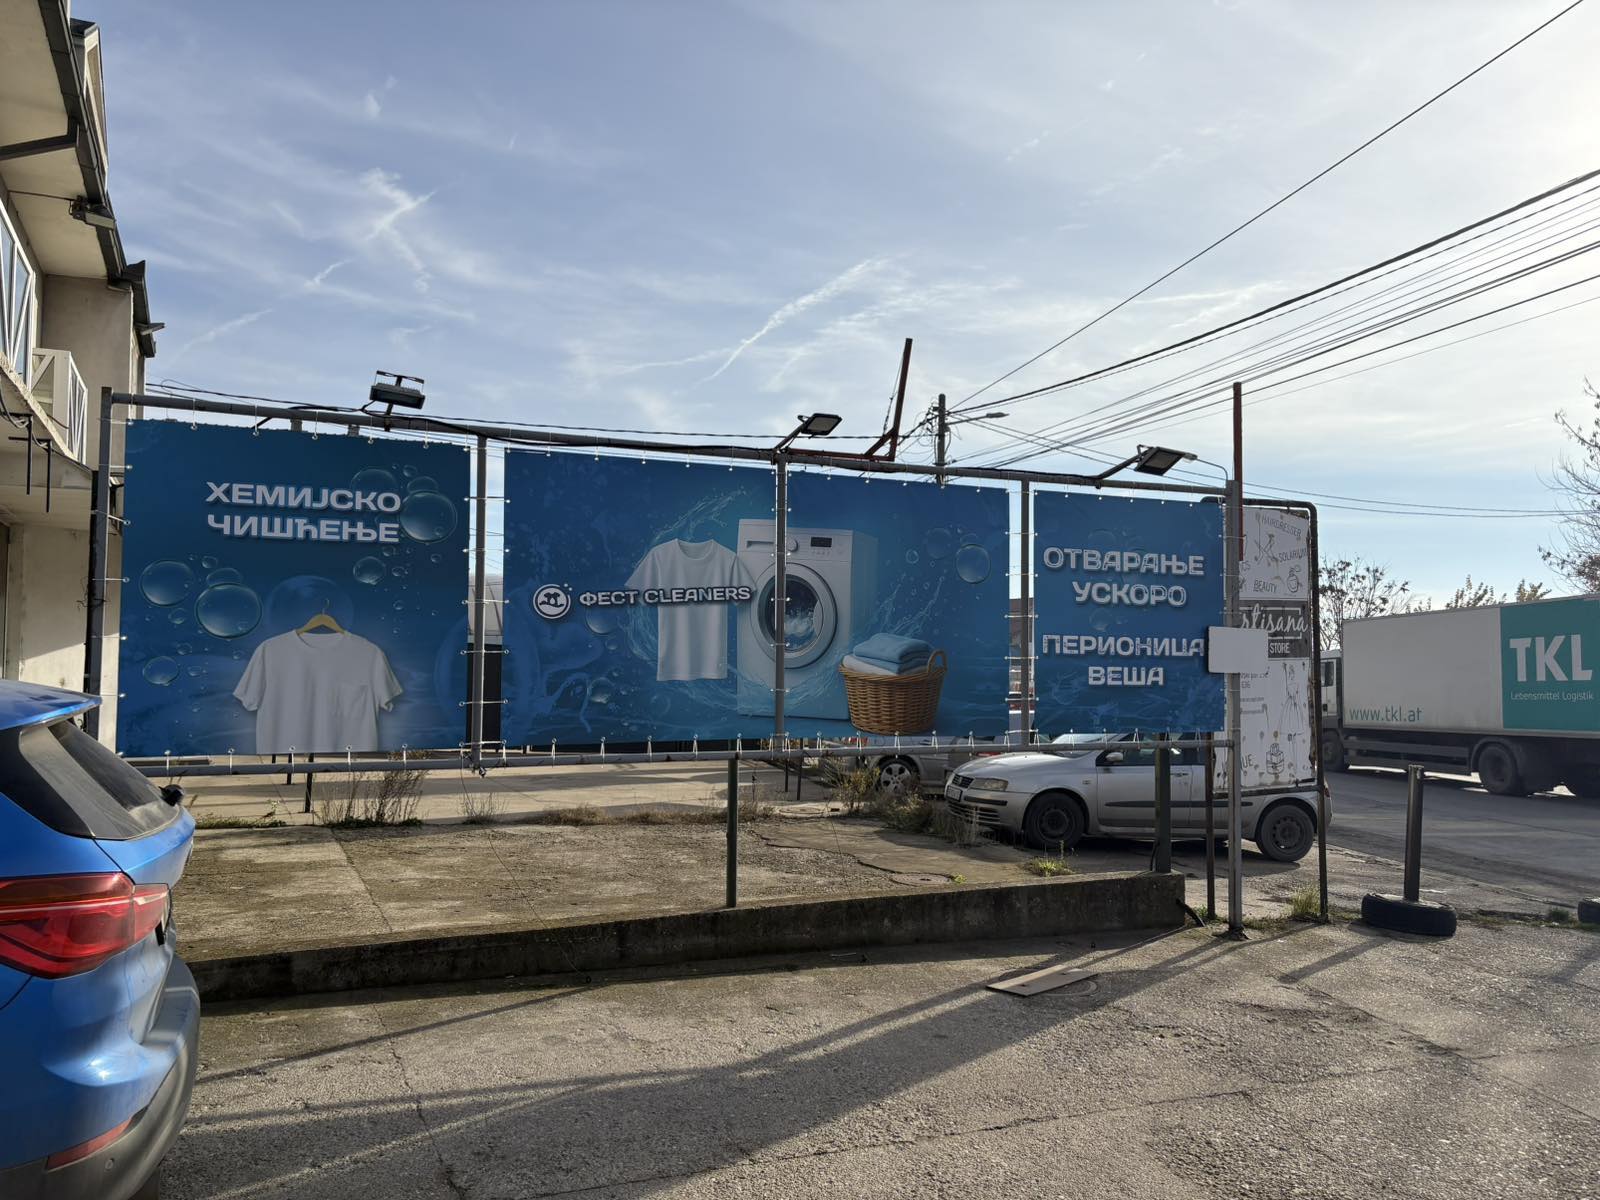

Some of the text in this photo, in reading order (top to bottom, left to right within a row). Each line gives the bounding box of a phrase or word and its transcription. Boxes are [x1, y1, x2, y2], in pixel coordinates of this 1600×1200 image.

[206, 481, 401, 512] ХЕМИЈСКО
[207, 514, 400, 543] ЧИШЋЕЊЕ
[1043, 547, 1205, 576] ОТВАРАЊЕ
[579, 586, 752, 606] ФЕСТ CLEANERS
[1072, 581, 1187, 606] УСКОРО
[1253, 579, 1277, 593] BEAUTY
[1042, 634, 1205, 657] ПЕРИОНИЦА
[1269, 642, 1290, 654] STORE
[1509, 634, 1593, 682] TKL
[1088, 666, 1164, 686] ВЕША
[1510, 690, 1594, 702] Lebensmittel Logistik
[1349, 706, 1423, 722] www.tkl.at
